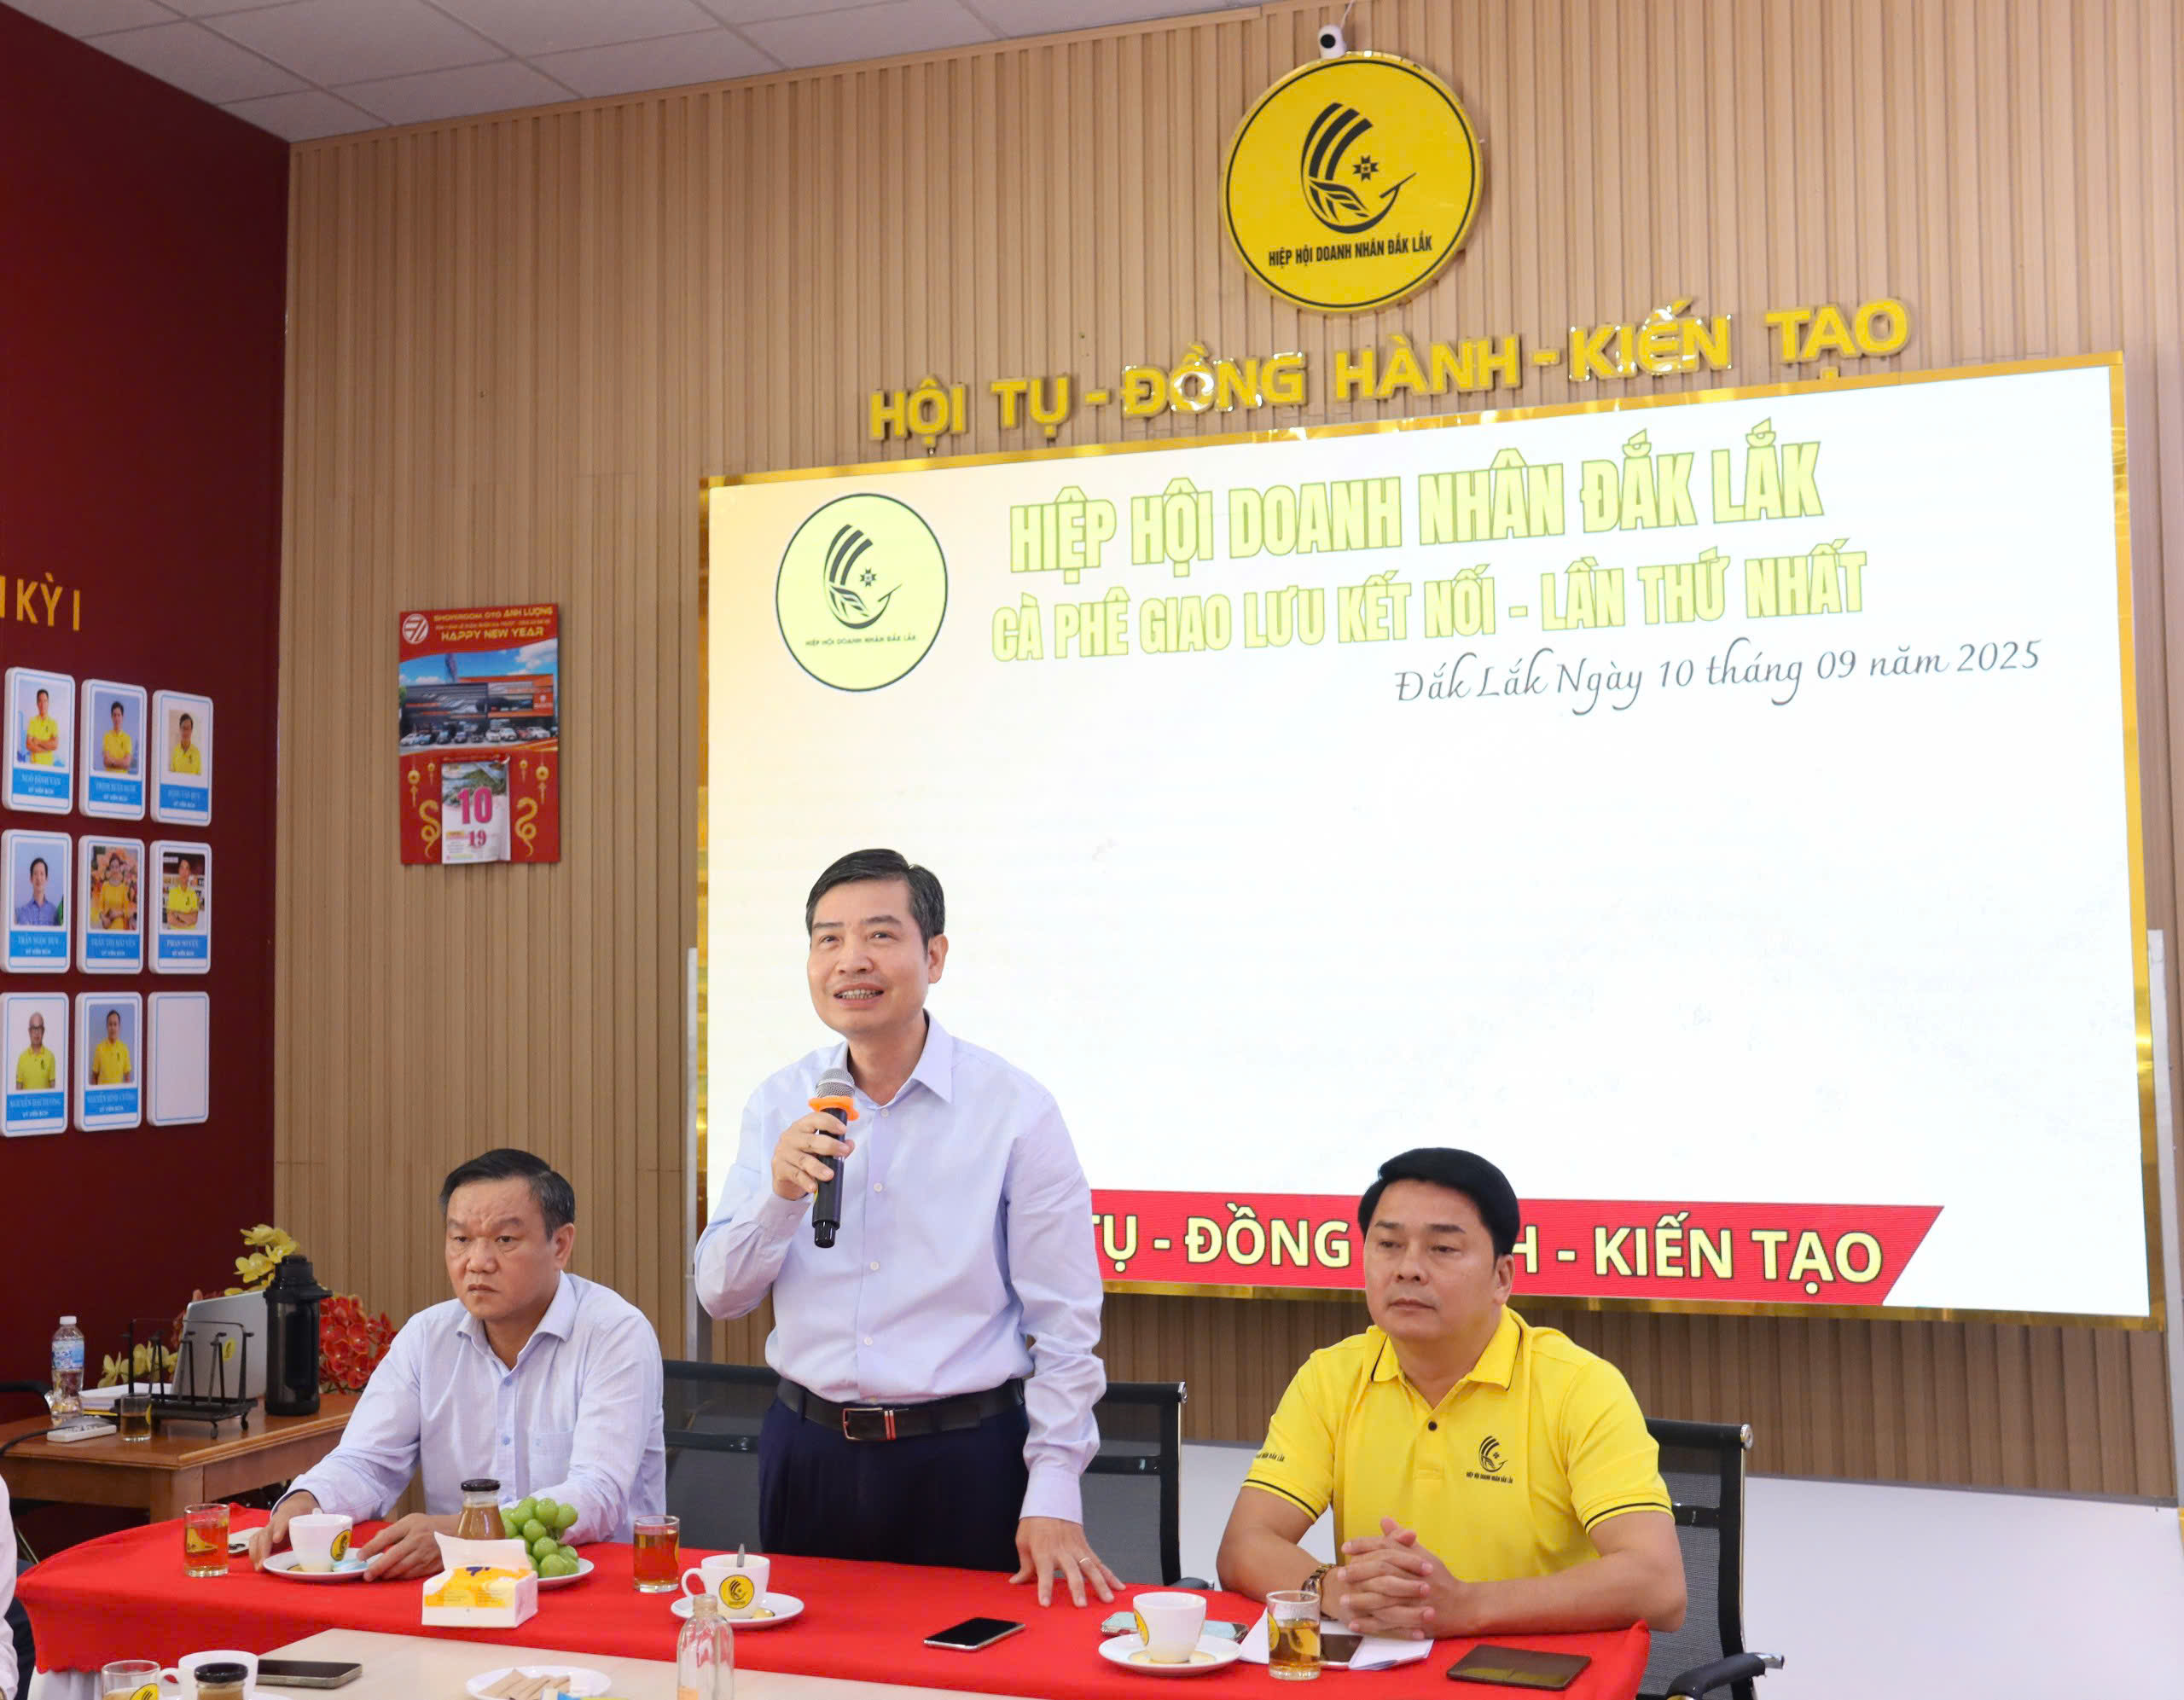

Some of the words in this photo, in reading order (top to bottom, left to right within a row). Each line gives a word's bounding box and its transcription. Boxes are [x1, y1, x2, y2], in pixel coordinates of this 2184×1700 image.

[1269, 247, 1292, 269] HIỆP
[1295, 243, 1313, 267] HỘI
[1316, 243, 1352, 263] DOANH
[1355, 237, 1385, 258] NHÂN
[1387, 232, 1409, 255] ĐẮK
[1412, 229, 1432, 252] LẮK
[870, 374, 969, 447] HỘI
[990, 374, 1072, 439] TỤ
[1084, 387, 1110, 407] -
[1121, 341, 1308, 419] ĐỒNG
[1334, 333, 1523, 402] HÀNH
[1531, 347, 1560, 368] -
[1568, 295, 1734, 382] KIẾN
[1764, 297, 1911, 380] TẠO
[1010, 485, 1117, 584] HIỆP
[1131, 477, 1213, 577] HỘI
[1228, 476, 1403, 559] DOANH
[1418, 448, 1565, 546] NHÂN
[1580, 428, 1698, 533] ĐẮK
[1711, 416, 1825, 524] LẮK
[17, 572, 62, 627] KỲ
[73, 589, 81, 632] I
[992, 592, 1043, 662] CÀ
[1054, 587, 1130, 659] PHÊ
[1139, 594, 1231, 654] GIAO
[1243, 585, 1325, 648] LƯU
[1337, 570, 1412, 643] KẾT
[1423, 564, 1496, 639] NỐI
[1508, 606, 1528, 618] -
[1541, 556, 1625, 631] LẦN
[1637, 546, 1730, 625] THỨ
[1745, 538, 1867, 619] NHẤT
[441, 630, 481, 641] HAPPY
[484, 628, 509, 639] NEW
[511, 627, 544, 637] YEAR
[1395, 652, 1478, 701] Đắk
[1476, 647, 1554, 697] Lắk
[1557, 657, 1642, 716] Ngày
[1659, 659, 1693, 688] 10
[1706, 636, 1803, 705] tháng
[1817, 650, 1856, 679] 09
[1869, 644, 1950, 676] năm
[1956, 638, 2042, 672] 2025
[457, 786, 492, 825] 10
[468, 829, 487, 847] 19
[1153, 1237, 1172, 1250] -
[1183, 1202, 1351, 1268] ĐỒNG
[1594, 1210, 1734, 1279] KIẾN
[1751, 1227, 1884, 1295] TẠO
